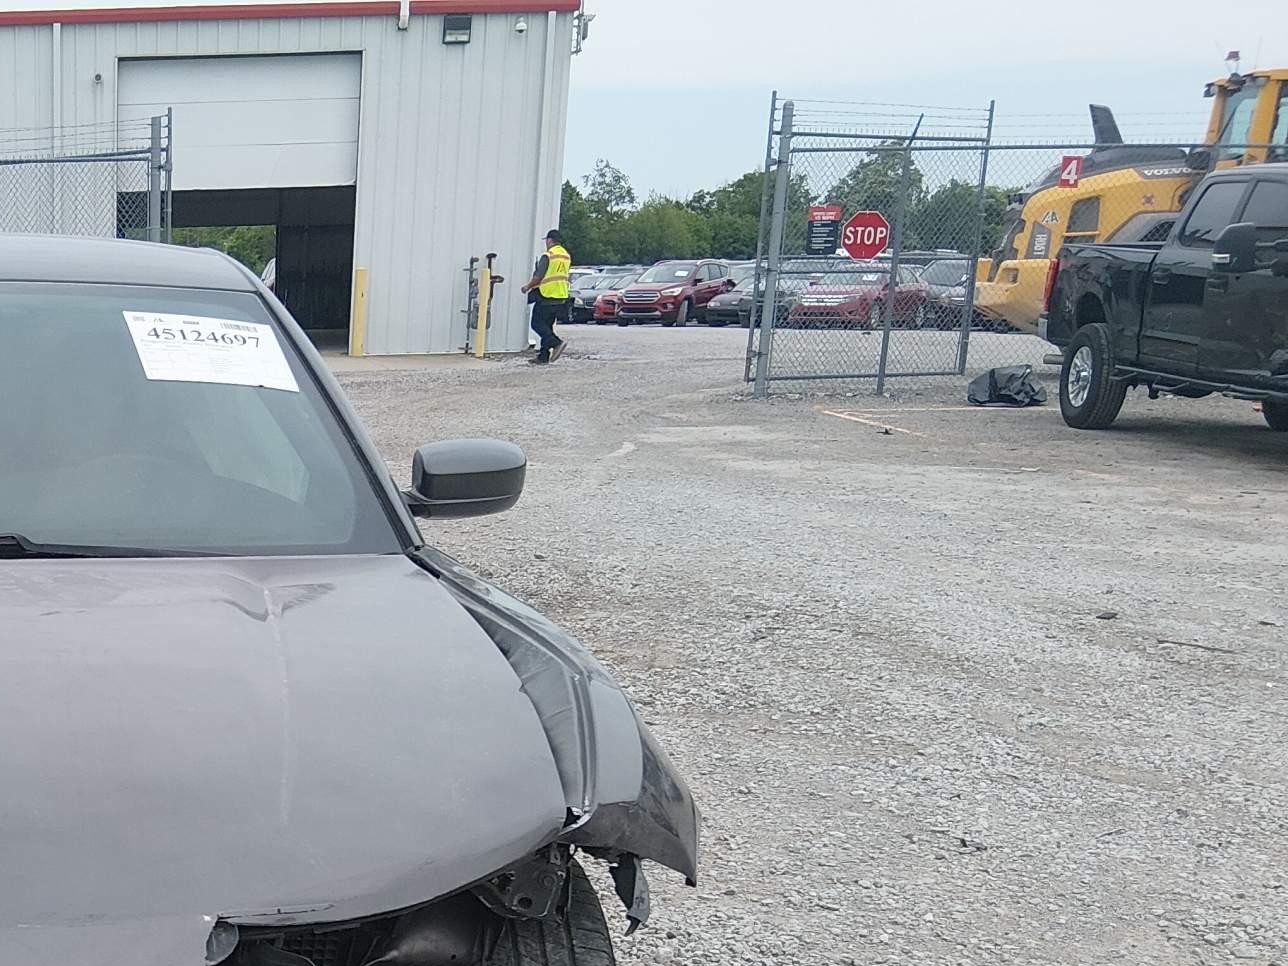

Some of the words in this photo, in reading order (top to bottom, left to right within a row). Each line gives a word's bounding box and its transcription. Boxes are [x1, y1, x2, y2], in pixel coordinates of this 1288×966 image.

[1062, 160, 1078, 184] 4
[844, 227, 886, 245] STOP
[147, 327, 260, 348] 45124697
